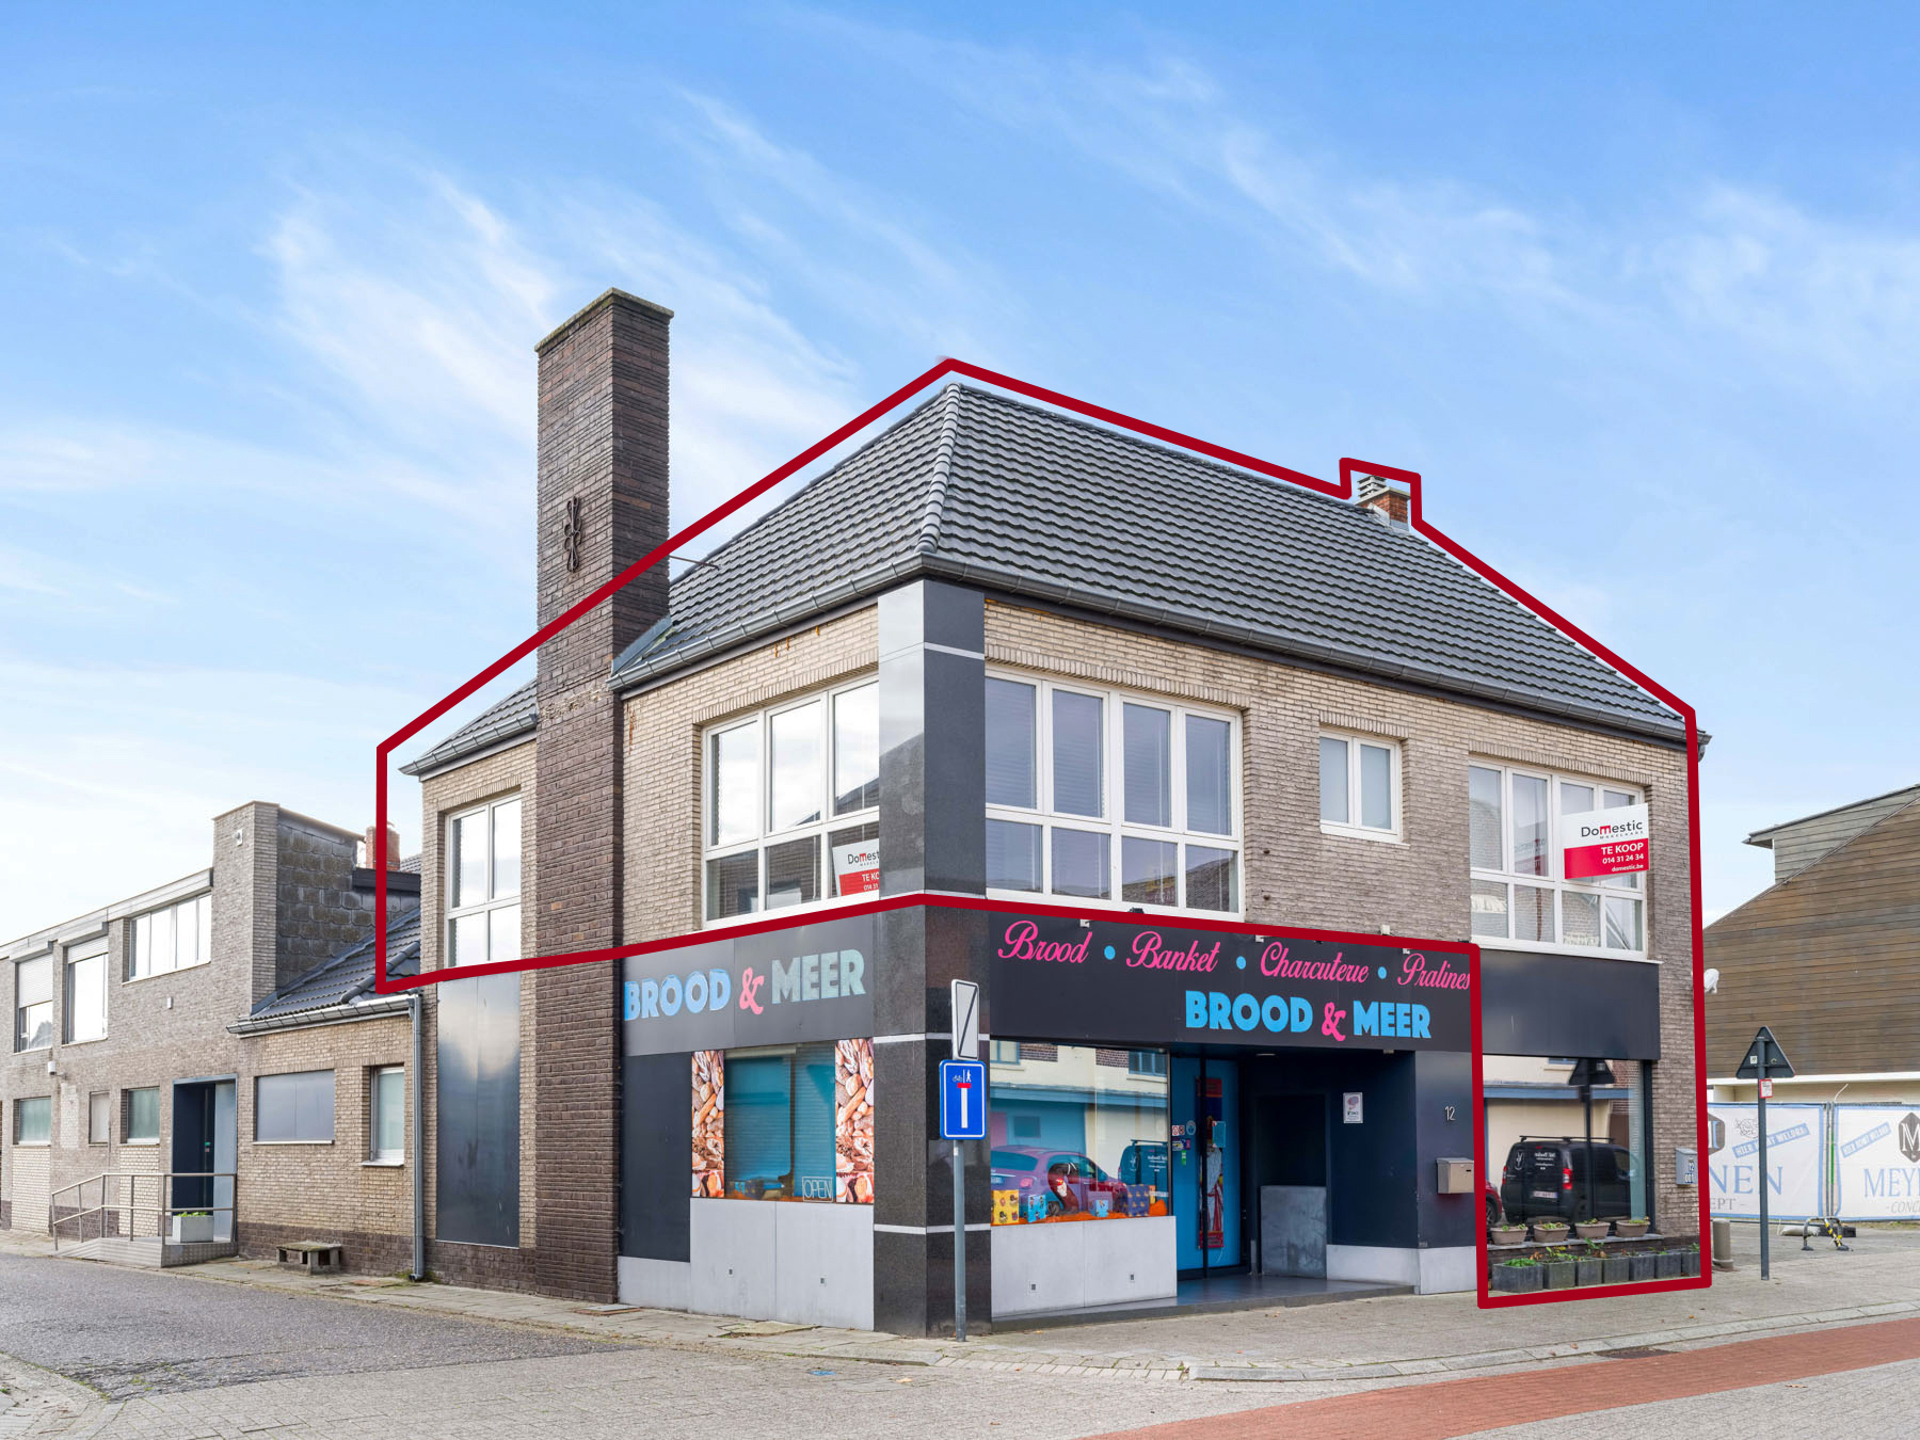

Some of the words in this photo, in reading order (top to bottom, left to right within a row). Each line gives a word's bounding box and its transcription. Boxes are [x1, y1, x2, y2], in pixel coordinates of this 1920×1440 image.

[1581, 820, 1643, 837] Domestic
[1601, 846, 1613, 855] TE
[1615, 843, 1644, 853] KOOP
[1616, 855, 1624, 863] 31
[1625, 854, 1634, 862] 24
[862, 873, 870, 882] TE
[998, 920, 1093, 963] Brood
[1126, 931, 1221, 972] Banket
[1397, 953, 1470, 989] Pralines
[624, 968, 732, 1021] BROOD
[739, 967, 765, 1015] &
[771, 949, 866, 1004] MEER
[1185, 990, 1313, 1033] BROOD
[1321, 1001, 1346, 1041] &
[1353, 1000, 1432, 1039] MEER
[1444, 1106, 1456, 1120] 12
[804, 1179, 832, 1198] OPEN
